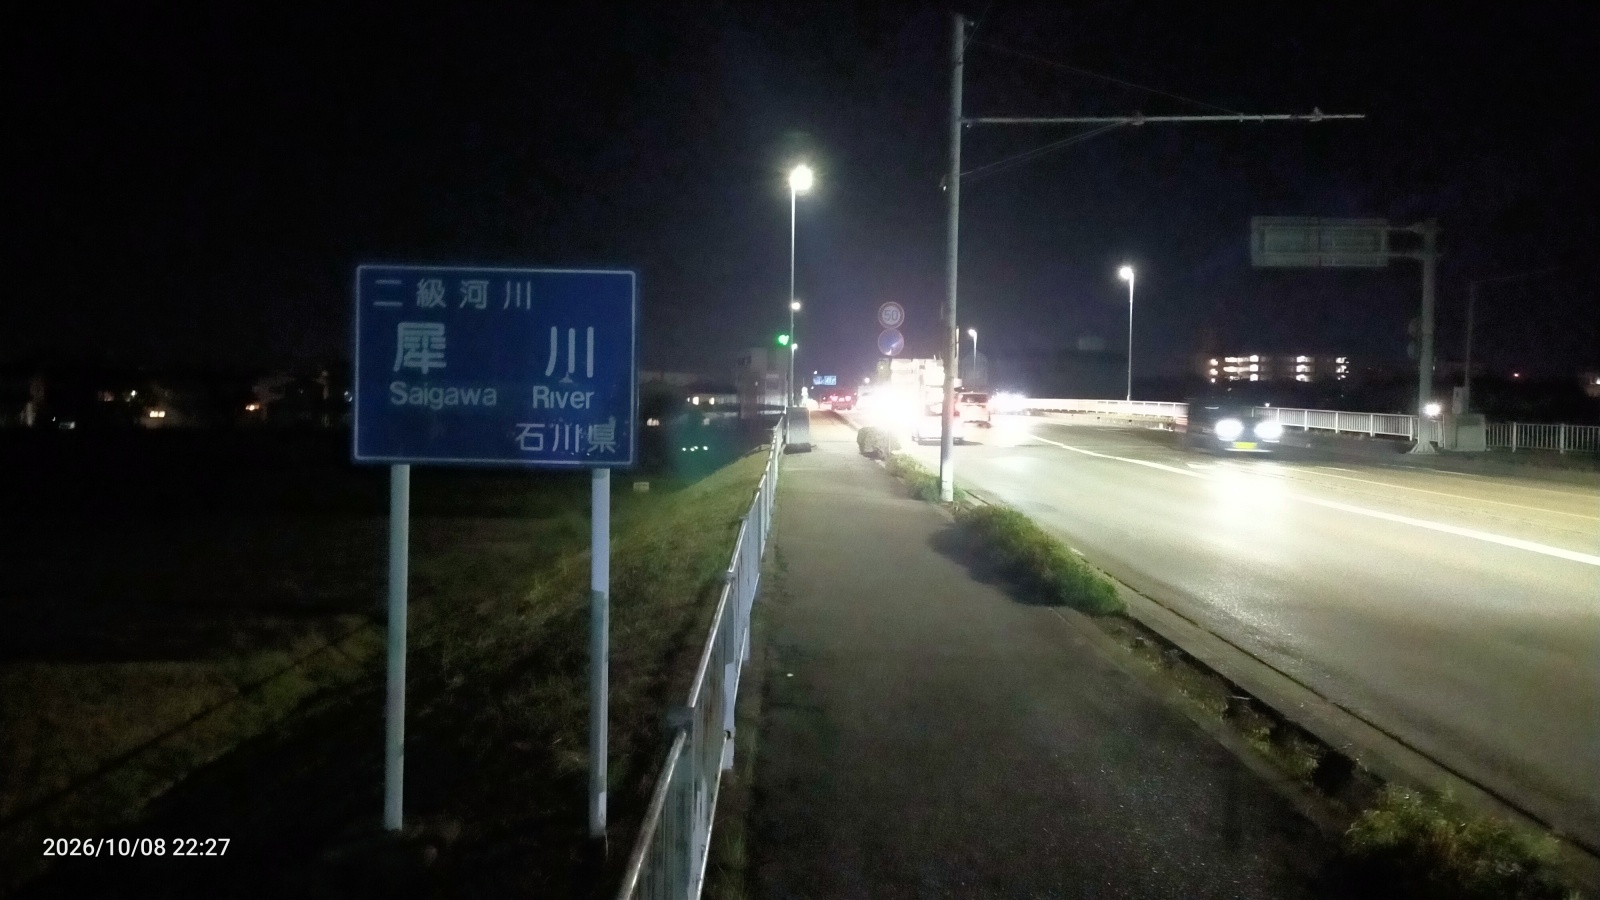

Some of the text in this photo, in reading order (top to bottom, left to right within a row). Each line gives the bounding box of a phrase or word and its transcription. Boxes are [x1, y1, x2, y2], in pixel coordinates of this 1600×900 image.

[373, 278, 532, 310] 二級河川
[884, 310, 898, 321] 50
[390, 382, 594, 410] Saigawa River
[515, 421, 617, 454] 石川県
